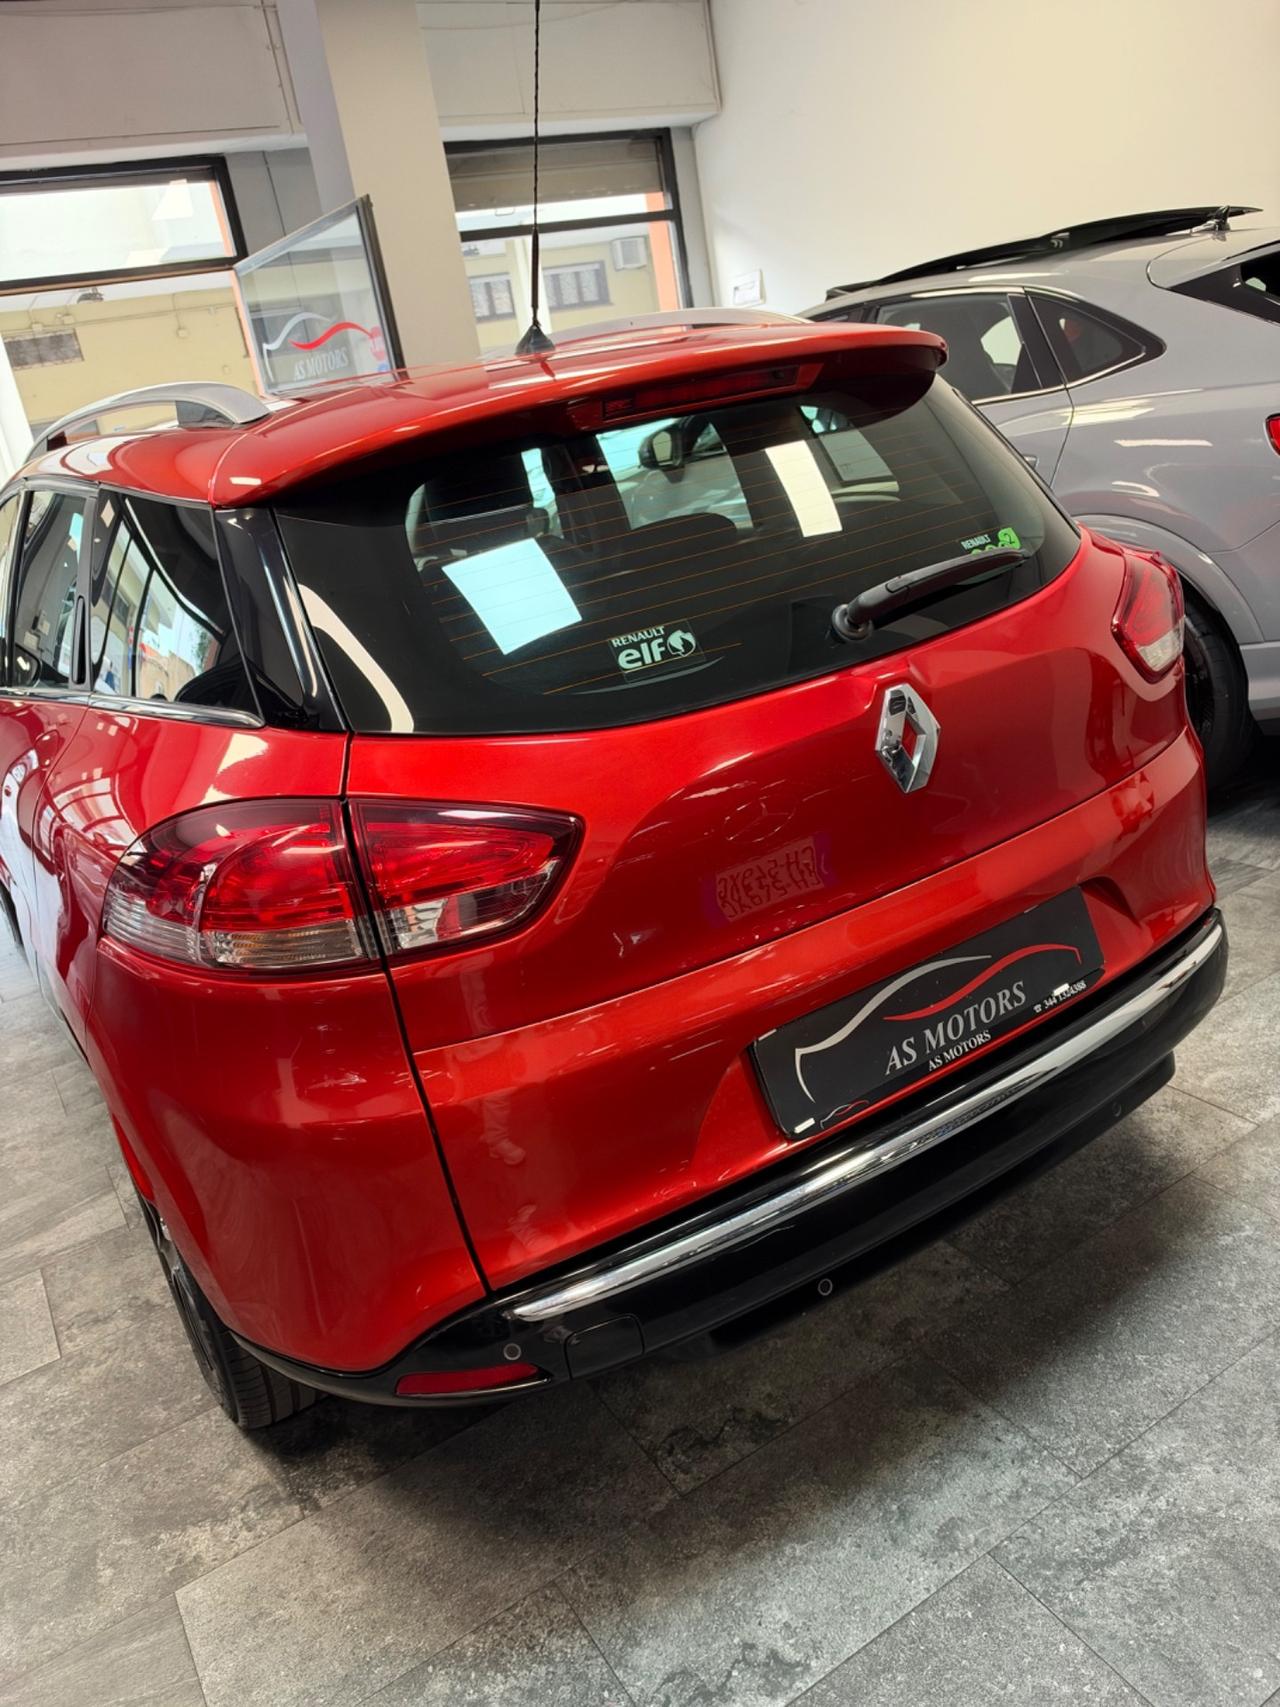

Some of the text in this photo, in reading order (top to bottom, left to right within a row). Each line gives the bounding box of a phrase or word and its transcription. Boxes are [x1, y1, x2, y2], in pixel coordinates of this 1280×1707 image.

[294, 346, 349, 381] AS MOTORS
[961, 534, 991, 550] RENAULT
[611, 625, 665, 648] RENAULT
[618, 638, 666, 669] elf
[884, 981, 1026, 1075] AS MOTORS
[928, 1030, 991, 1071] AS MOTORS
